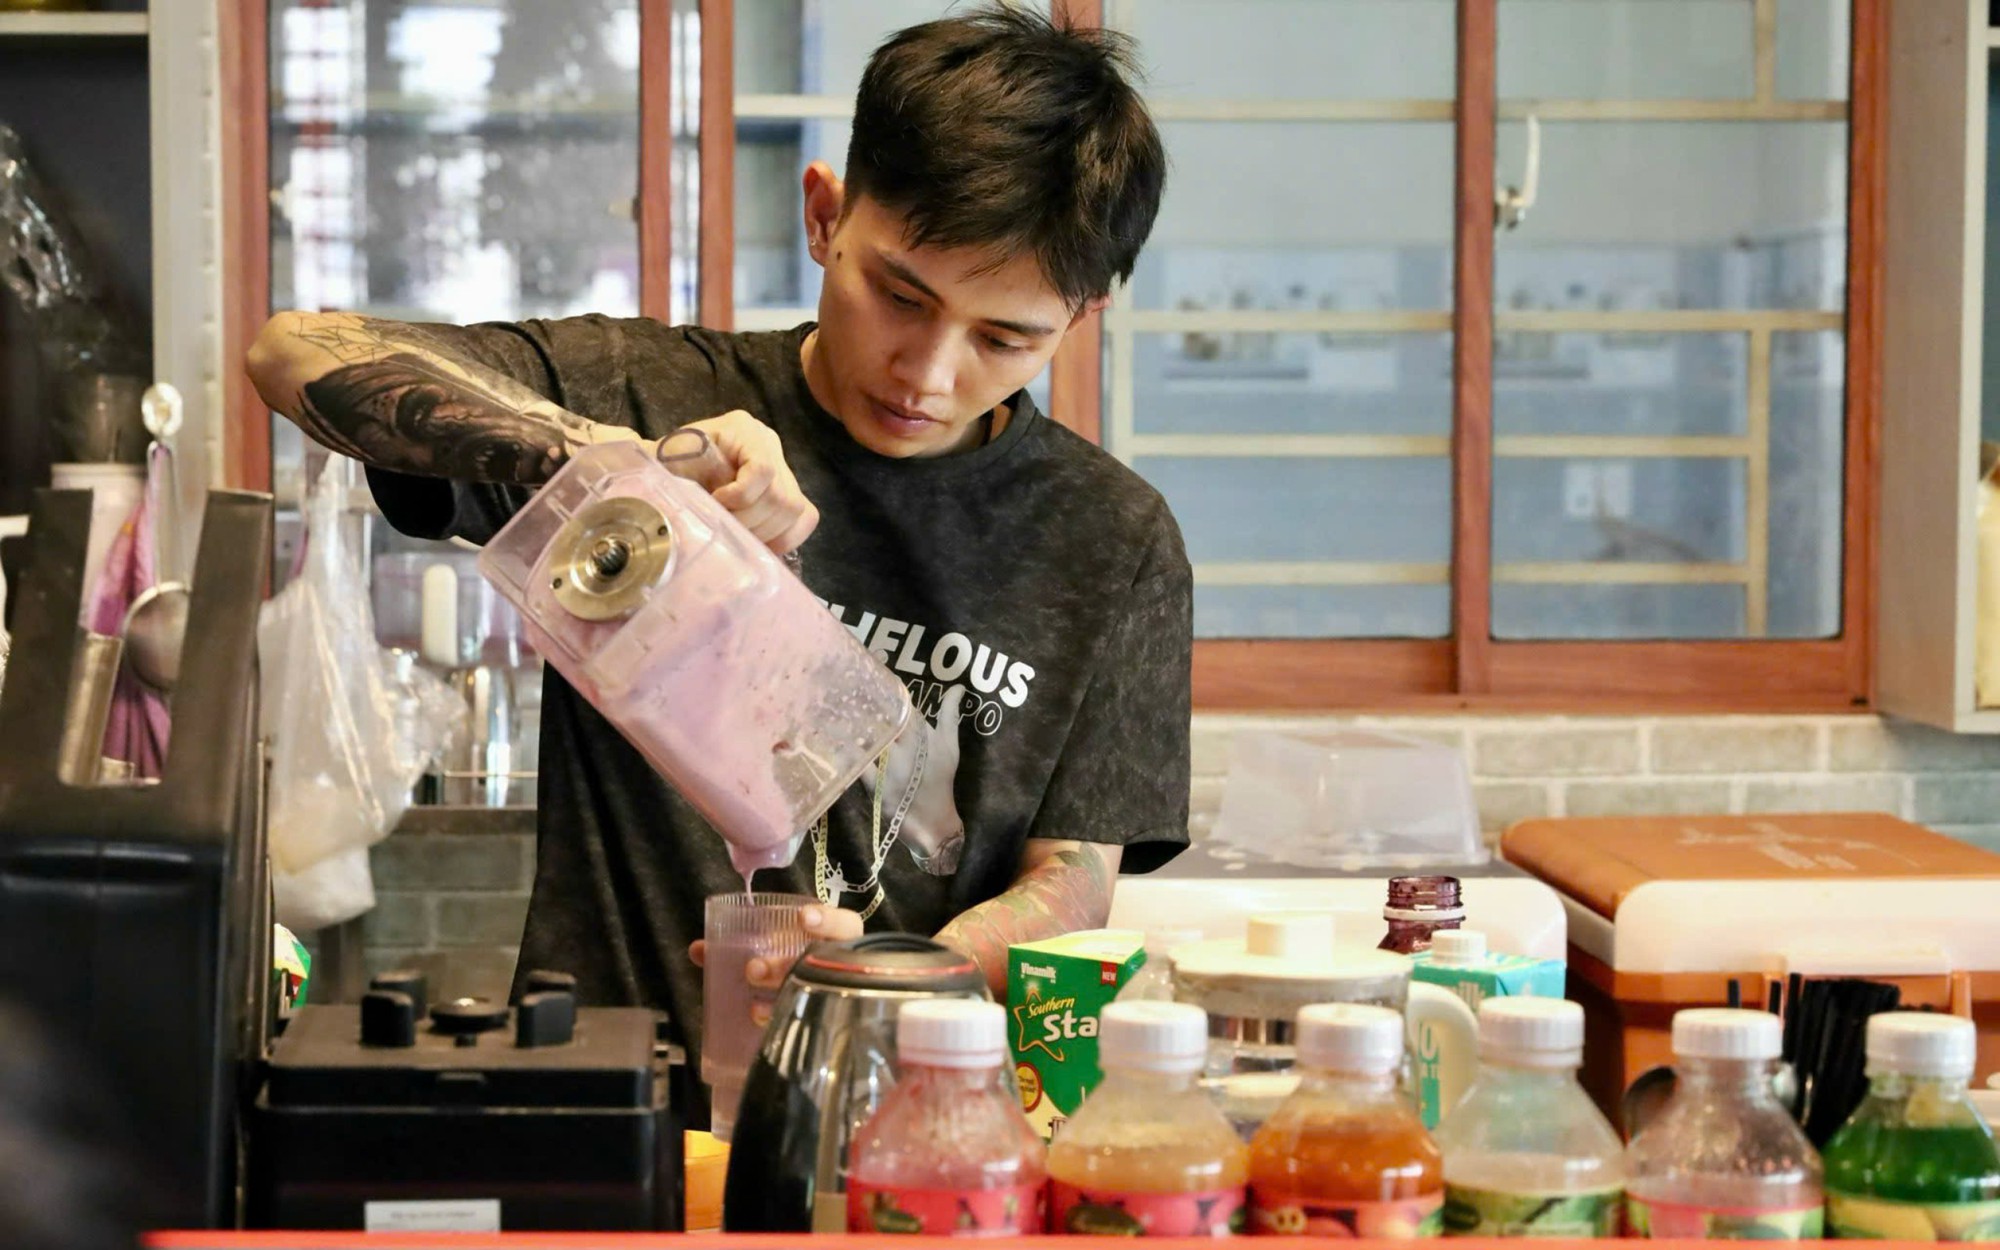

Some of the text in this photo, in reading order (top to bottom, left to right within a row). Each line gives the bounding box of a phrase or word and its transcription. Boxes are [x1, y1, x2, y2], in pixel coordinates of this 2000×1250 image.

[815, 597, 1035, 708] HELOUS
[1101, 971, 1117, 981] NEW
[1028, 997, 1075, 1018] Southern
